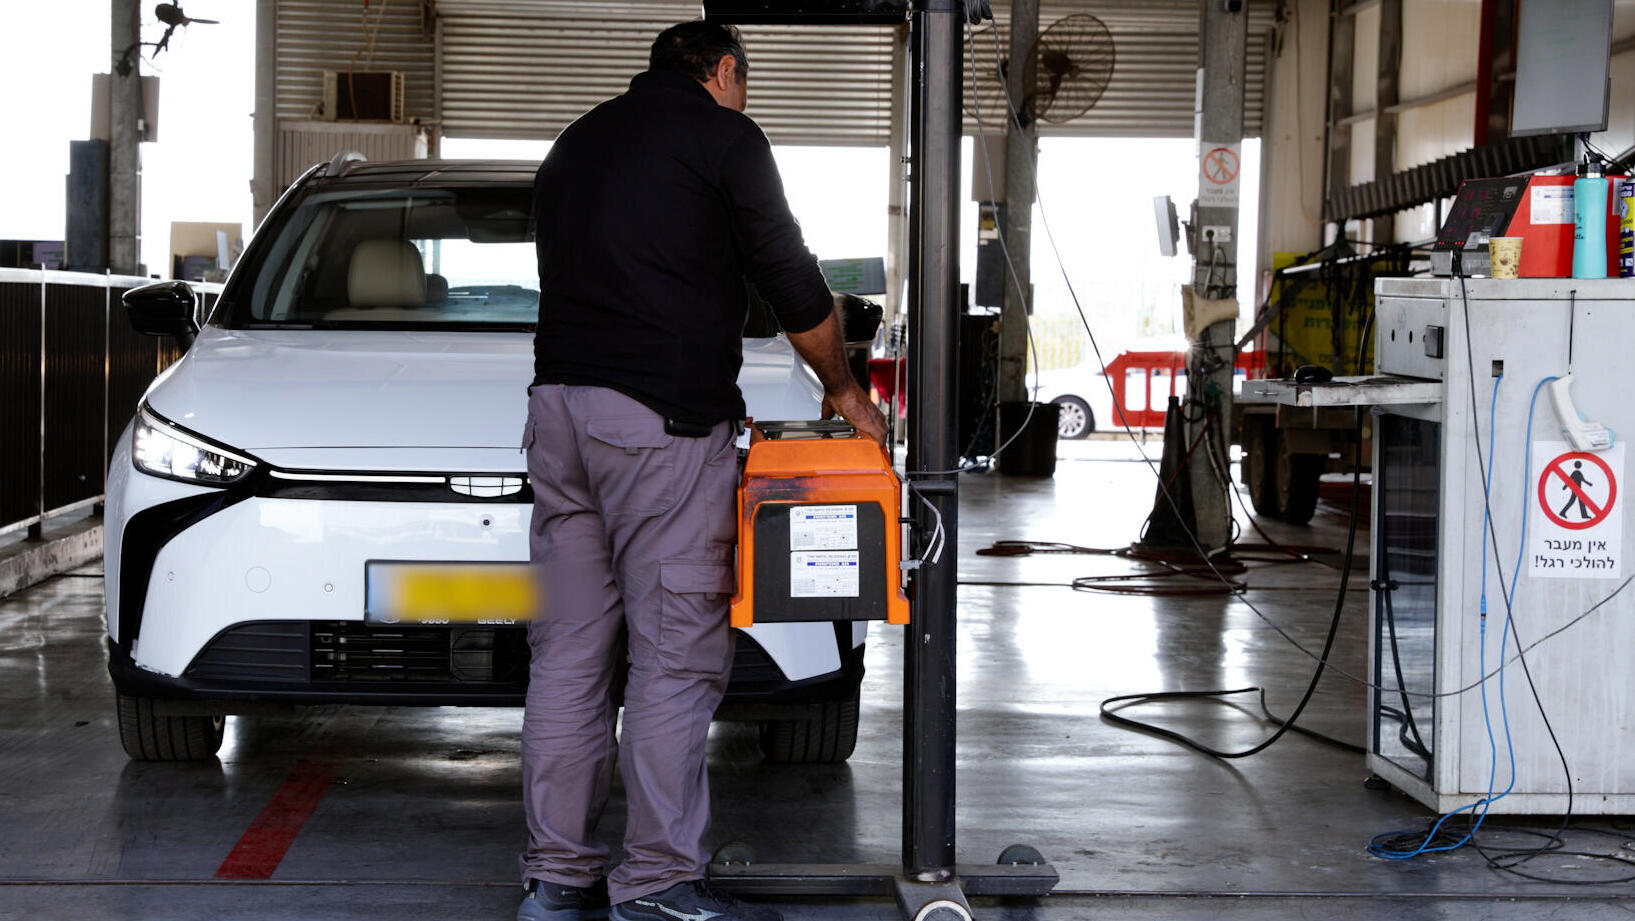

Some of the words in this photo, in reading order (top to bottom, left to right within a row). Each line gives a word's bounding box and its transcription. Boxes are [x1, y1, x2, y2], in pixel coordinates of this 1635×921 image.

[1544, 540, 1582, 551] מעבר
[1588, 540, 1606, 553] אין
[1535, 555, 1564, 569] רגל!
[1570, 556, 1615, 569] להולכי
